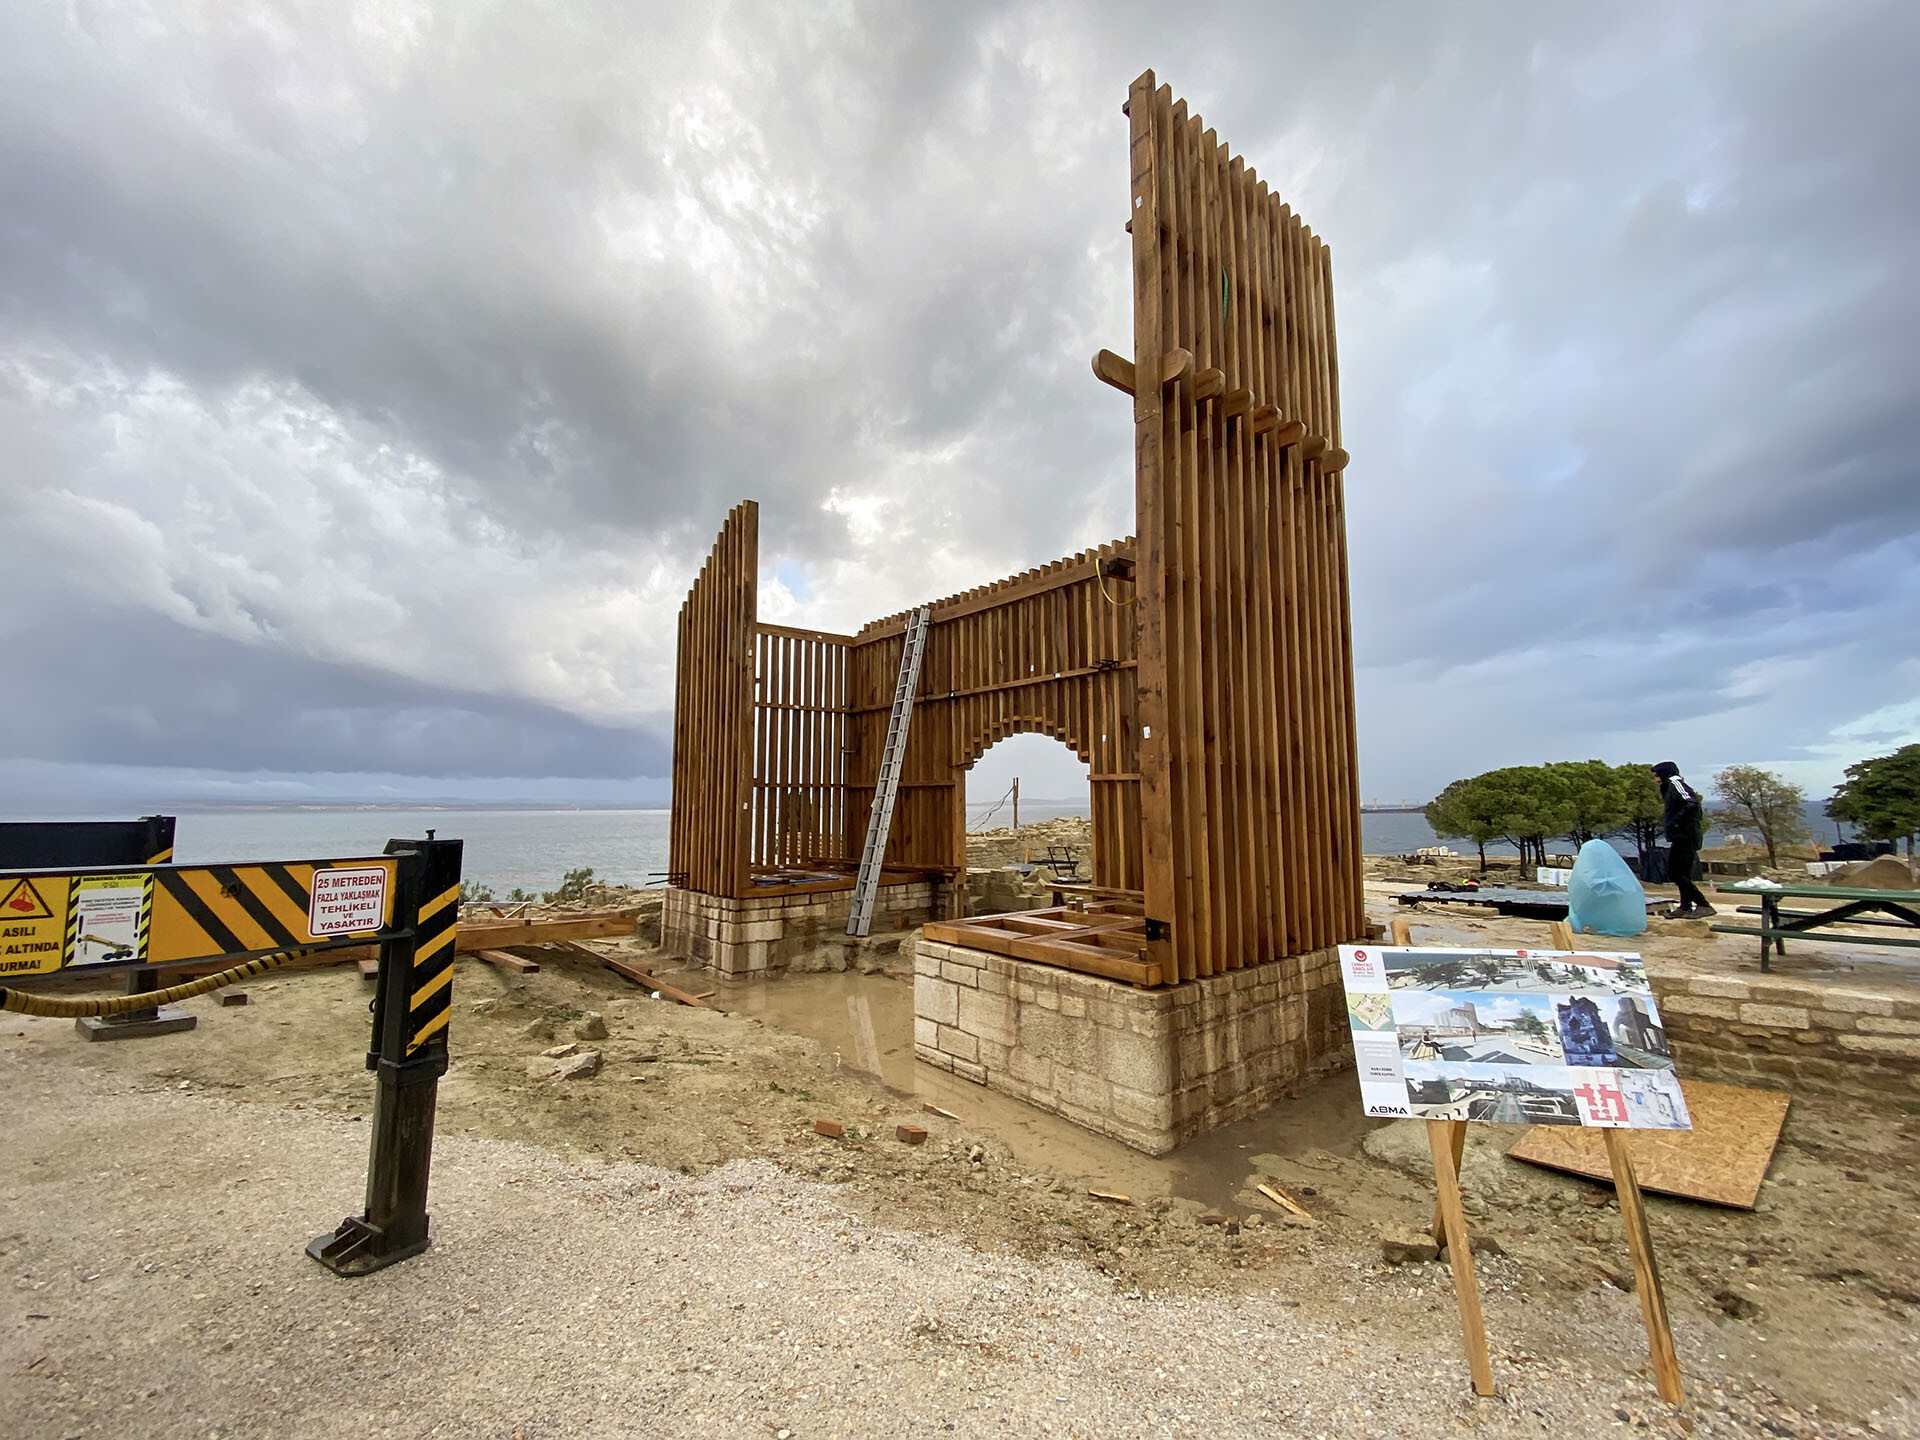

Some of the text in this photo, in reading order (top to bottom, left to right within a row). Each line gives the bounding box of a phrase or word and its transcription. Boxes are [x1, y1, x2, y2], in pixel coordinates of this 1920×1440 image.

[317, 876, 382, 888] 25 METREDEN
[317, 890, 380, 902] FAZLA YAKLAŞMAK
[320, 901, 376, 913] TEHLİKELİ
[320, 918, 374, 929] YASAKTIR
[2, 926, 36, 938] ASILI
[5, 941, 60, 955] ALTINDA
[1369, 1105, 1408, 1115] ABMA
